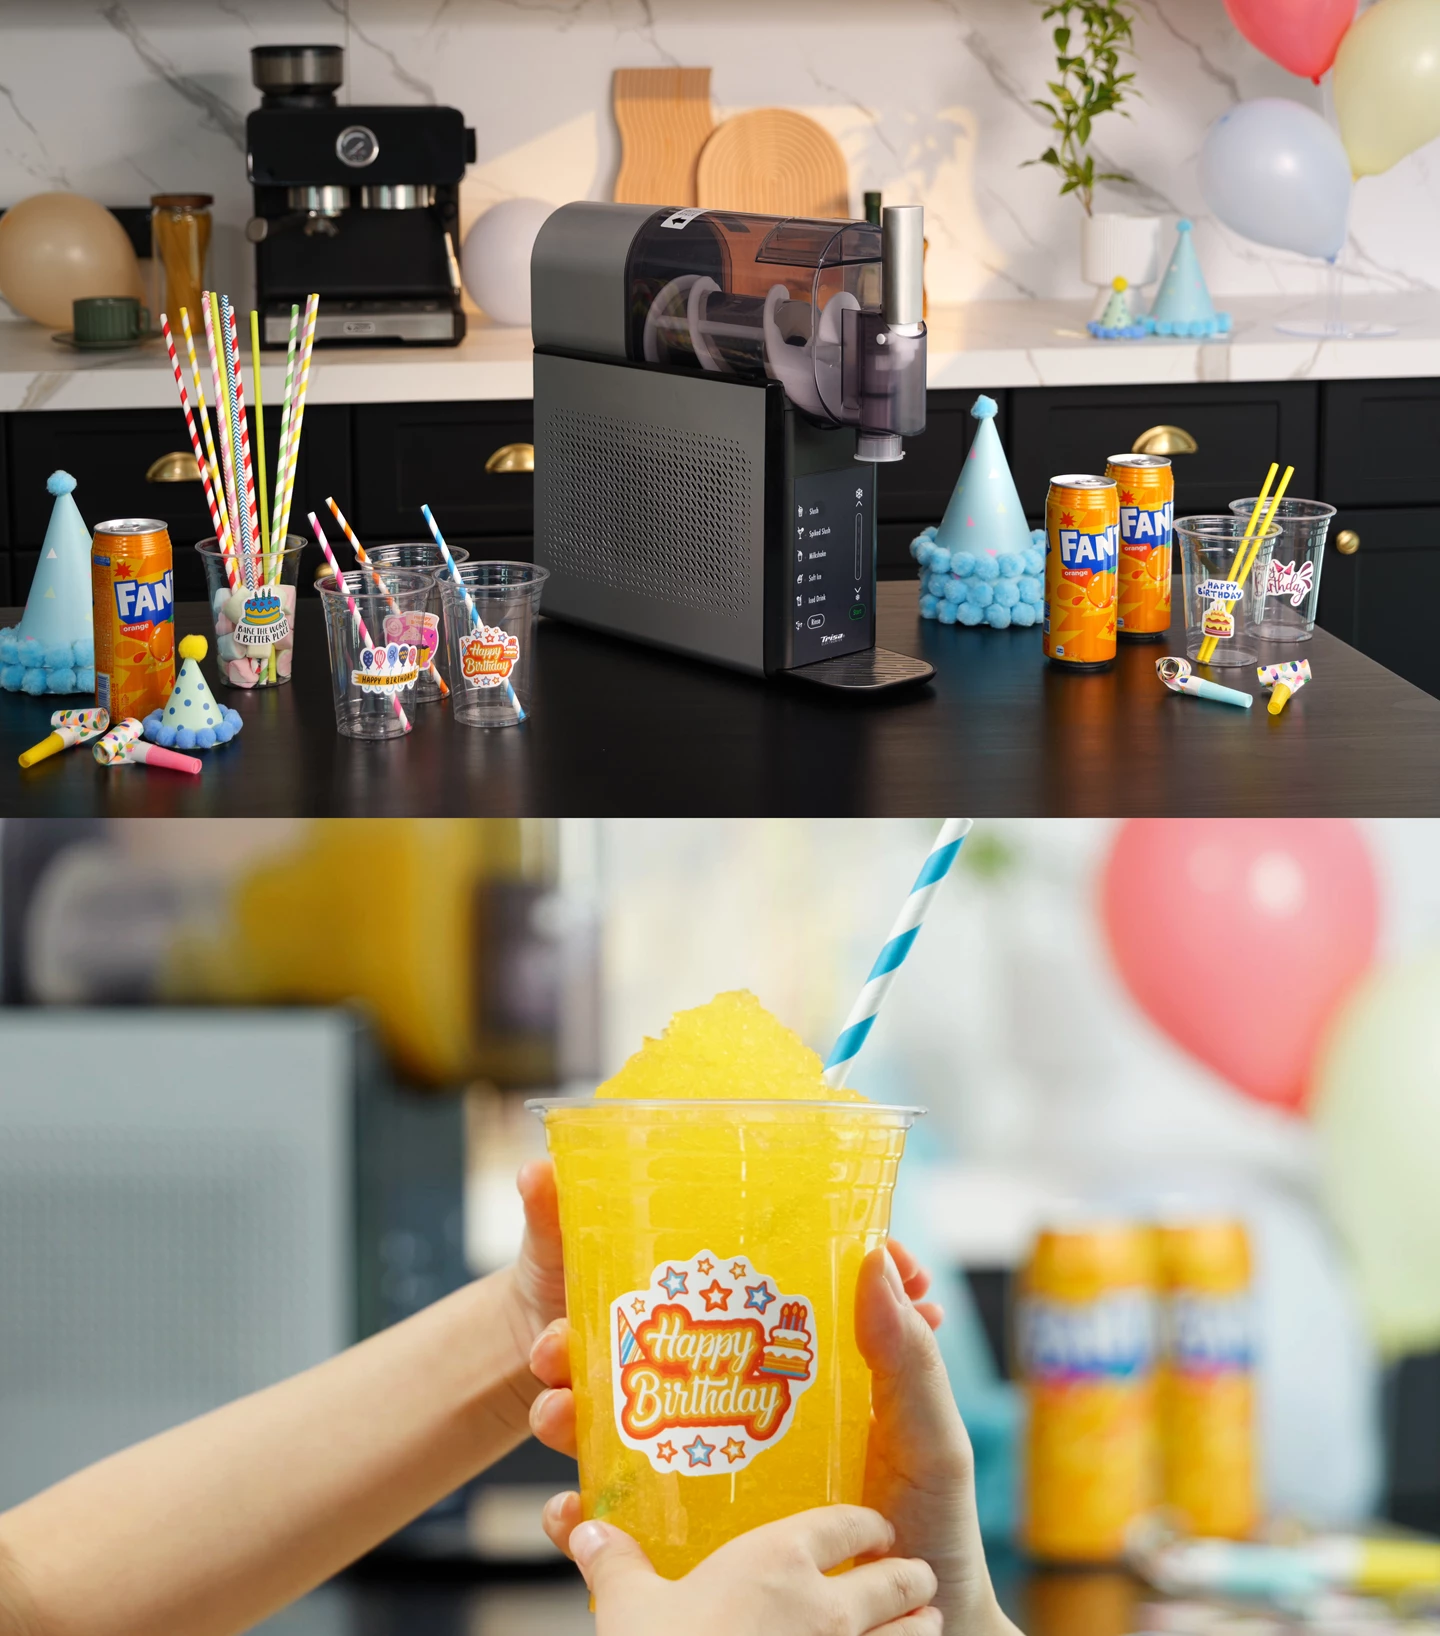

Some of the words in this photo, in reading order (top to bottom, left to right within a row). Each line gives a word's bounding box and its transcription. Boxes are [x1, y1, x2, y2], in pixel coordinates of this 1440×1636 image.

[809, 529, 821, 538] Spiked
[809, 550, 827, 560] Milkshake
[808, 574, 816, 582] Soft
[1207, 581, 1237, 591] HAPPY
[816, 594, 826, 602] Drink
[123, 622, 149, 633] orange
[237, 625, 254, 635] BAKE
[257, 627, 268, 635] THE
[269, 619, 288, 633] WORLD
[235, 633, 241, 641] A
[243, 635, 271, 643] BETTER
[272, 627, 289, 641] PLACE
[820, 633, 844, 643] Trisa
[470, 643, 501, 660] Happy
[465, 657, 509, 675] Birthday
[362, 675, 382, 684] HAPPY
[645, 1315, 754, 1374] Happy
[630, 1370, 780, 1429] Birthday
